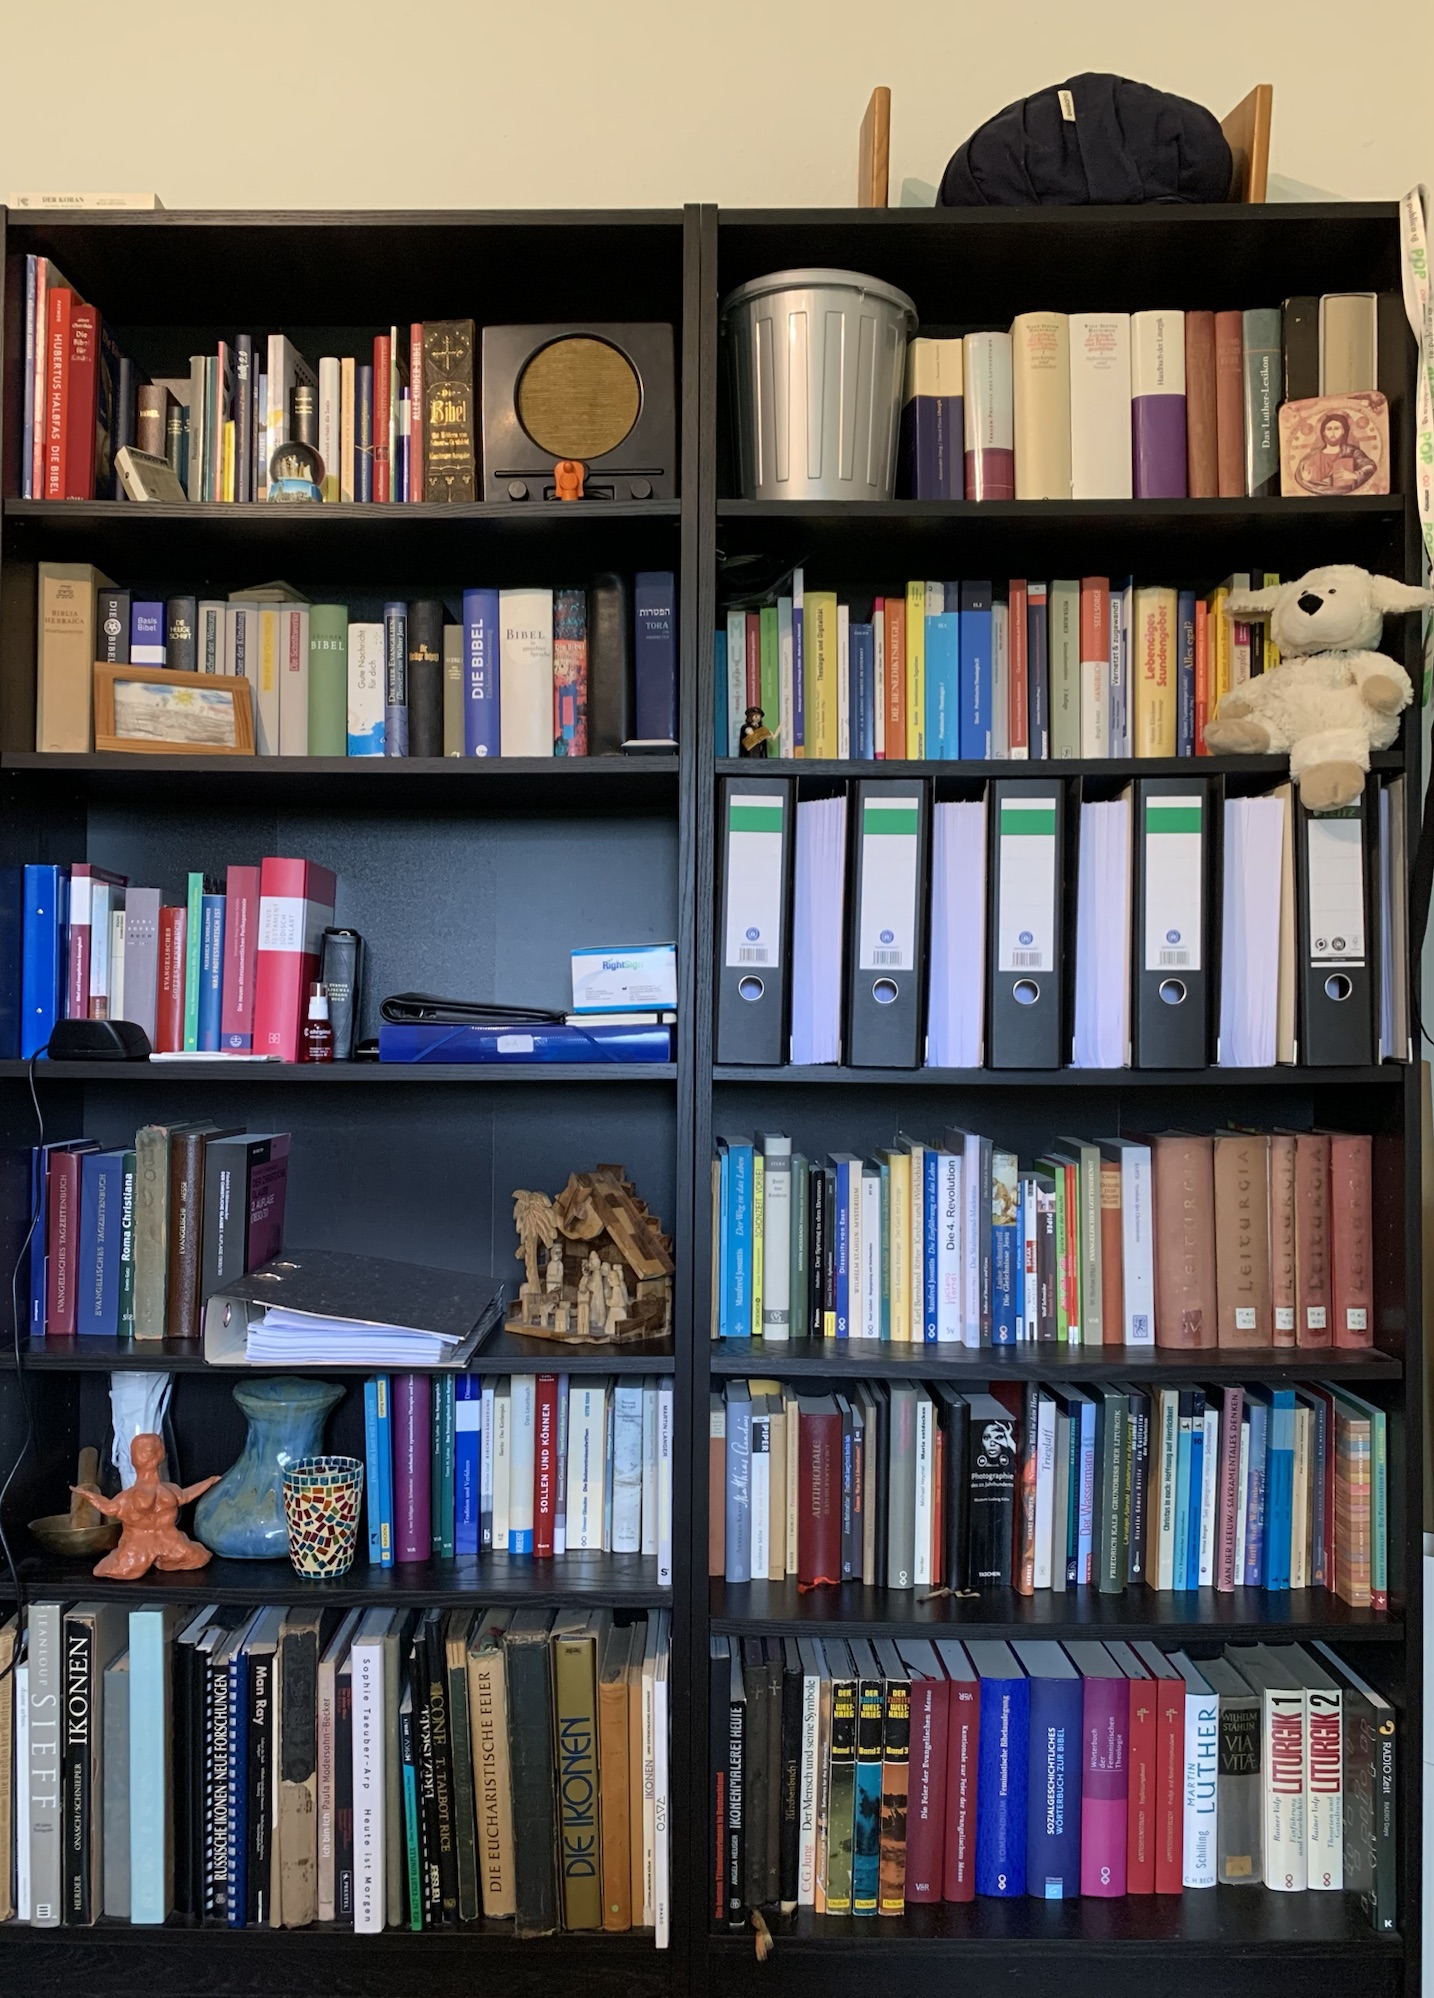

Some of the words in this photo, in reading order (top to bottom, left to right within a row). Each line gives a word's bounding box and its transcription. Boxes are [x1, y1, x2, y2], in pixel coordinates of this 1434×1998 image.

[1410, 248, 1427, 280] POP
[52, 334, 63, 389] HUBERTUS
[1260, 356, 1270, 427] Luther-Lexikon
[51, 393, 61, 439] HALBFAS
[430, 400, 467, 424] Bibel
[51, 445, 60, 462] DIE
[1261, 430, 1271, 448] Das
[49, 465, 59, 494] BIBEL
[109, 601, 117, 618] DIE
[137, 617, 157, 625] Basis
[1112, 601, 1120, 644] zugewandt
[290, 612, 300, 657] Schriftwerke
[645, 621, 669, 630] TORA
[1184, 620, 1195, 645] egal?
[310, 640, 345, 651] BIBEL
[357, 629, 366, 668] Nachricht
[470, 618, 484, 668] BIBEL
[1144, 612, 1156, 680] Lebendiges
[290, 658, 300, 671] Die
[368, 660, 377, 677] dich
[817, 652, 825, 681] Theologie
[891, 618, 900, 703] BENEDIKTSREGEL
[1112, 652, 1120, 685] Vernetzt
[1183, 646, 1193, 671] Alles
[358, 669, 366, 689] Gute
[367, 678, 377, 689] für
[471, 671, 484, 699] DIE
[891, 705, 900, 722] DIE
[213, 907, 221, 919] IST
[239, 898, 247, 937] Perikopentexte
[264, 909, 272, 928] NEUE
[279, 914, 287, 945] JÜDISCH
[163, 927, 171, 990] EVANGELISCHES
[171, 919, 181, 999] GOTTESDIENSTBUCH
[212, 920, 221, 973] PROTESTANTISCH
[238, 938, 246, 985] alttestamentlichen
[602, 960, 644, 971] RightSign
[736, 1156, 744, 1179] Leben
[122, 1173, 133, 1229] Christiana
[180, 1181, 188, 1201] MESSE
[736, 1181, 744, 1195] das
[946, 1160, 956, 1218] Revolution
[59, 1174, 68, 1245] TAGZEITENBUCH
[96, 1173, 106, 1242] TAGZEITENBUCH
[736, 1204, 744, 1220] Weg
[1237, 1151, 1253, 1292] LEITURGIA
[179, 1207, 187, 1255] EVANGELISCHE
[735, 1220, 744, 1236] Der
[946, 1221, 955, 1231] 4.
[121, 1231, 131, 1261] Roma
[946, 1232, 956, 1251] Die
[735, 1248, 744, 1276] Josuttis
[57, 1247, 67, 1313] EVANGELISCHES
[94, 1246, 105, 1316] EVANGELISCHES
[735, 1276, 744, 1307] Manfred
[541, 1403, 550, 1445] KÖNNEN
[1113, 1409, 1121, 1446] LITURGIK
[1165, 1406, 1174, 1441] Herrlichkeit
[1229, 1394, 1239, 1431] DENKEN
[761, 1424, 769, 1451] PIPER
[1040, 1427, 1053, 1472] Trieglaff
[1164, 1441, 1173, 1452] auf
[540, 1449, 549, 1471] UND
[1112, 1448, 1120, 1464] DER
[1164, 1453, 1172, 1482] Hoffnung
[1227, 1434, 1238, 1508] SAKRAMENTALES
[971, 1472, 1014, 1481] Photographie
[1080, 1451, 1093, 1517] Wassermann
[1111, 1465, 1120, 1510] GRUNDRISS
[1164, 1483, 1172, 1499] euch:
[540, 1474, 549, 1513] SOLLEN
[1080, 1520, 1091, 1537] Der
[1111, 1513, 1119, 1535] KALB
[1163, 1507, 1171, 1532] Christus
[1225, 1515, 1234, 1545] LEEUW
[516, 1531, 524, 1553] KREUZ
[1225, 1547, 1233, 1564] DER
[1110, 1537, 1118, 1579] FRIEDRICH
[1224, 1567, 1233, 1585] VAN
[36, 1614, 48, 1686] JEANLOUP
[68, 1635, 88, 1745] IKONEN
[255, 1666, 268, 1696] Man
[362, 1658, 371, 1702] Sophie
[478, 1672, 492, 1715] FEIER
[838, 1689, 852, 1697] DER
[214, 1674, 228, 1752] FORSCHUNGEN
[253, 1699, 267, 1726] Ray
[805, 1680, 817, 1722] Symbole
[834, 1710, 854, 1718] KRIEG
[1271, 1697, 1302, 1706] 1
[1309, 1694, 1340, 1707] 2
[362, 1708, 372, 1790] Taeuber-Arp
[805, 1723, 815, 1748] seine
[1056, 1727, 1065, 1752] BIBEL
[1226, 1736, 1253, 1752] VIA
[31, 1693, 57, 1809] SIEFF
[804, 1750, 814, 1770] und
[1056, 1753, 1064, 1772] ZUR
[1196, 1705, 1216, 1814] LUTHER
[1271, 1712, 1303, 1794] LITURGIK
[1310, 1711, 1340, 1794] LITURGIK
[214, 1753, 228, 1780] NEUE
[560, 1717, 594, 1827] IKONEN
[644, 1759, 654, 1800] IKONEN
[1046, 1727, 1056, 1835] SOZIALGESCHICHTLICHES
[482, 1719, 501, 1860] EUCHARISTISCHE
[803, 1772, 814, 1806] Mensch
[1187, 1762, 1196, 1807] MARTIN
[214, 1785, 228, 1825] IKONEN
[1055, 1774, 1064, 1834] WÖRTERBUCH
[362, 1808, 372, 1846] Heute
[803, 1808, 813, 1831] Der
[214, 1827, 228, 1880] RUSSISCHE
[362, 1853, 372, 1870] ist
[564, 1835, 596, 1878] DIE
[801, 1845, 814, 1868] Jung
[1196, 1830, 1210, 1869] Schilling
[489, 1865, 502, 1893] DIE
[801, 1869, 812, 1893] C.G.
[362, 1876, 373, 1923] Morgen
